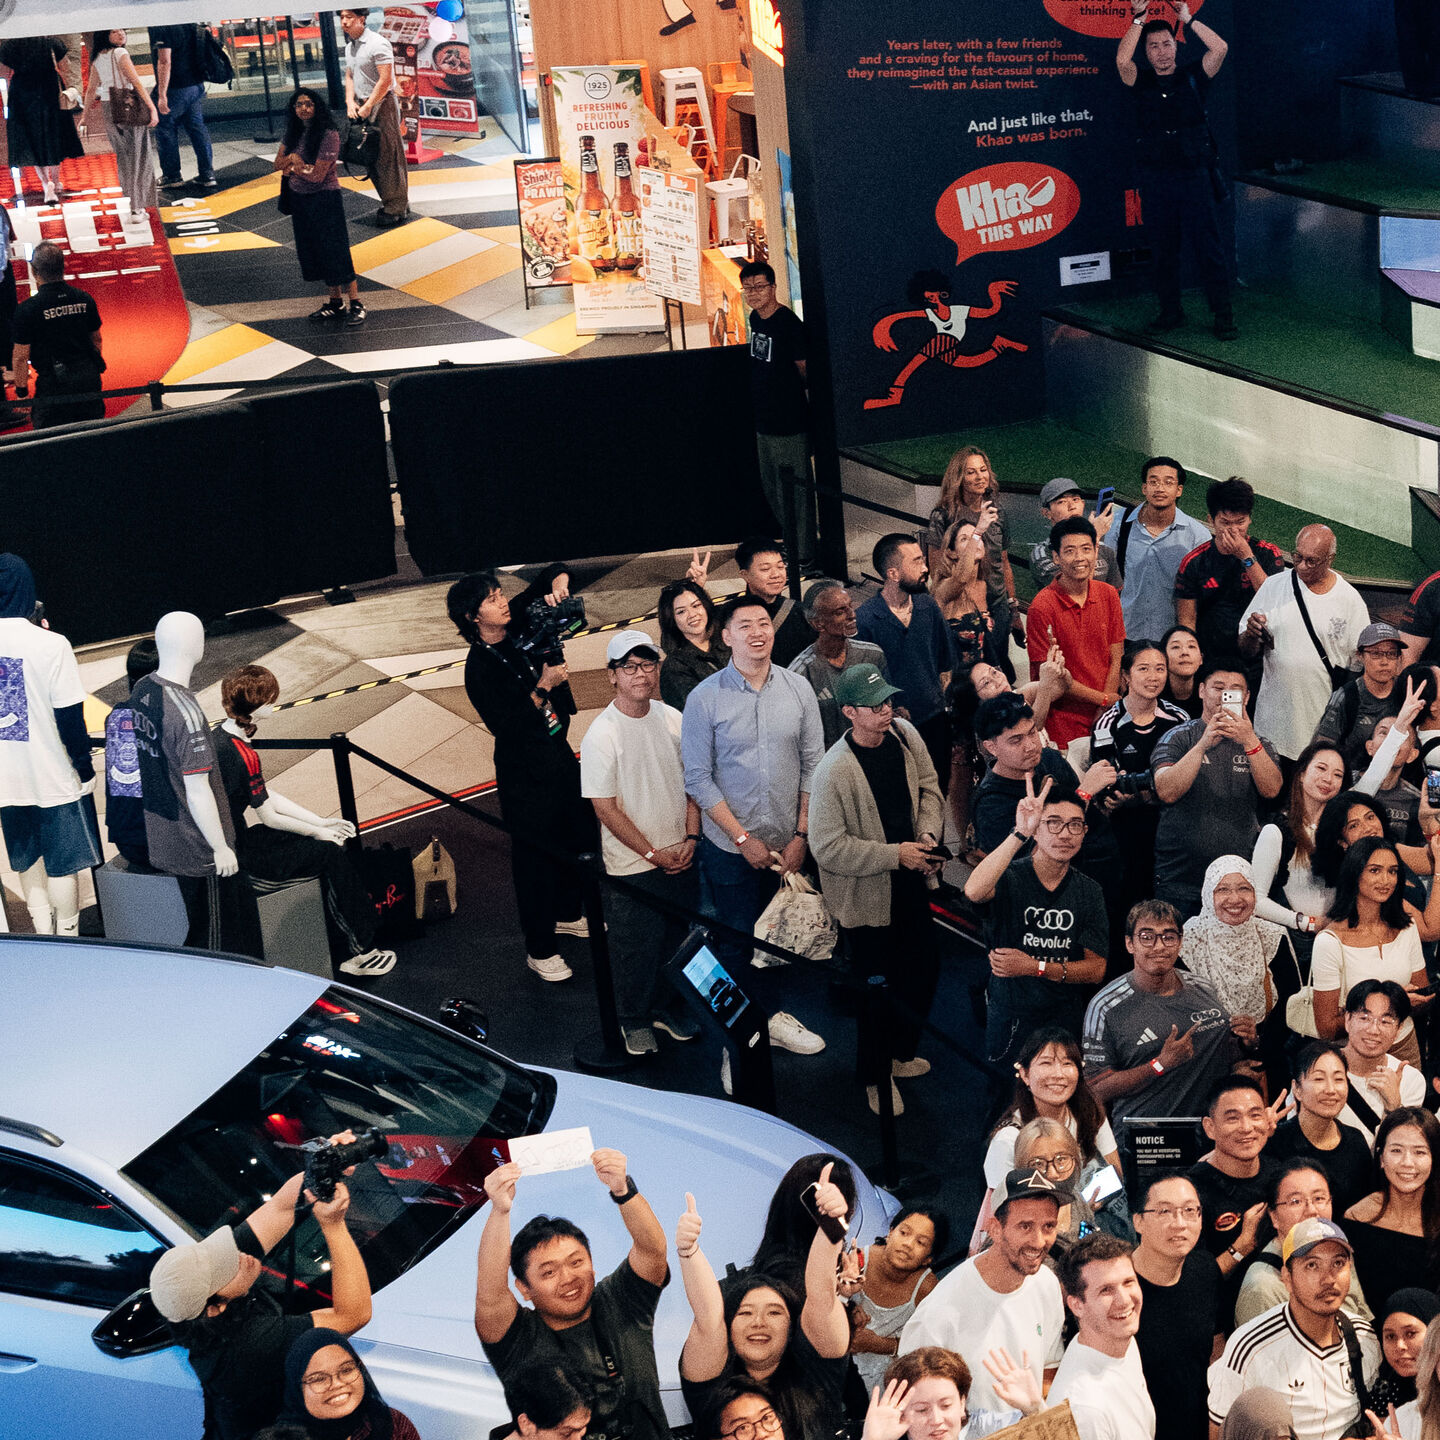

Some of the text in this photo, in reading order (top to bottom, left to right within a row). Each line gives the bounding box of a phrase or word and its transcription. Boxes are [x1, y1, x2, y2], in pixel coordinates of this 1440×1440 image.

[1080, 5, 1126, 17] thinking
[887, 38, 1062, 51] Years later, with a few friends
[859, 52, 1087, 66] and a craving for the flavours of home,
[847, 65, 1099, 81] they reimagined the fast-casual experience
[587, 81, 608, 89] 1925
[952, 82, 967, 90] an
[970, 80, 1002, 89] Asian
[1005, 79, 1038, 89] twist.
[572, 102, 628, 113] REFRESHING
[584, 111, 620, 121] FRUITY
[967, 109, 1093, 133] And just like that,
[576, 120, 630, 131] DELICIOUS
[976, 126, 1087, 148] Khao was born.
[977, 213, 1054, 245] THIS WAY
[43, 303, 87, 320] SECURITY
[1022, 932, 1072, 949] Revolut
[1135, 1136, 1165, 1145] NOTICE
